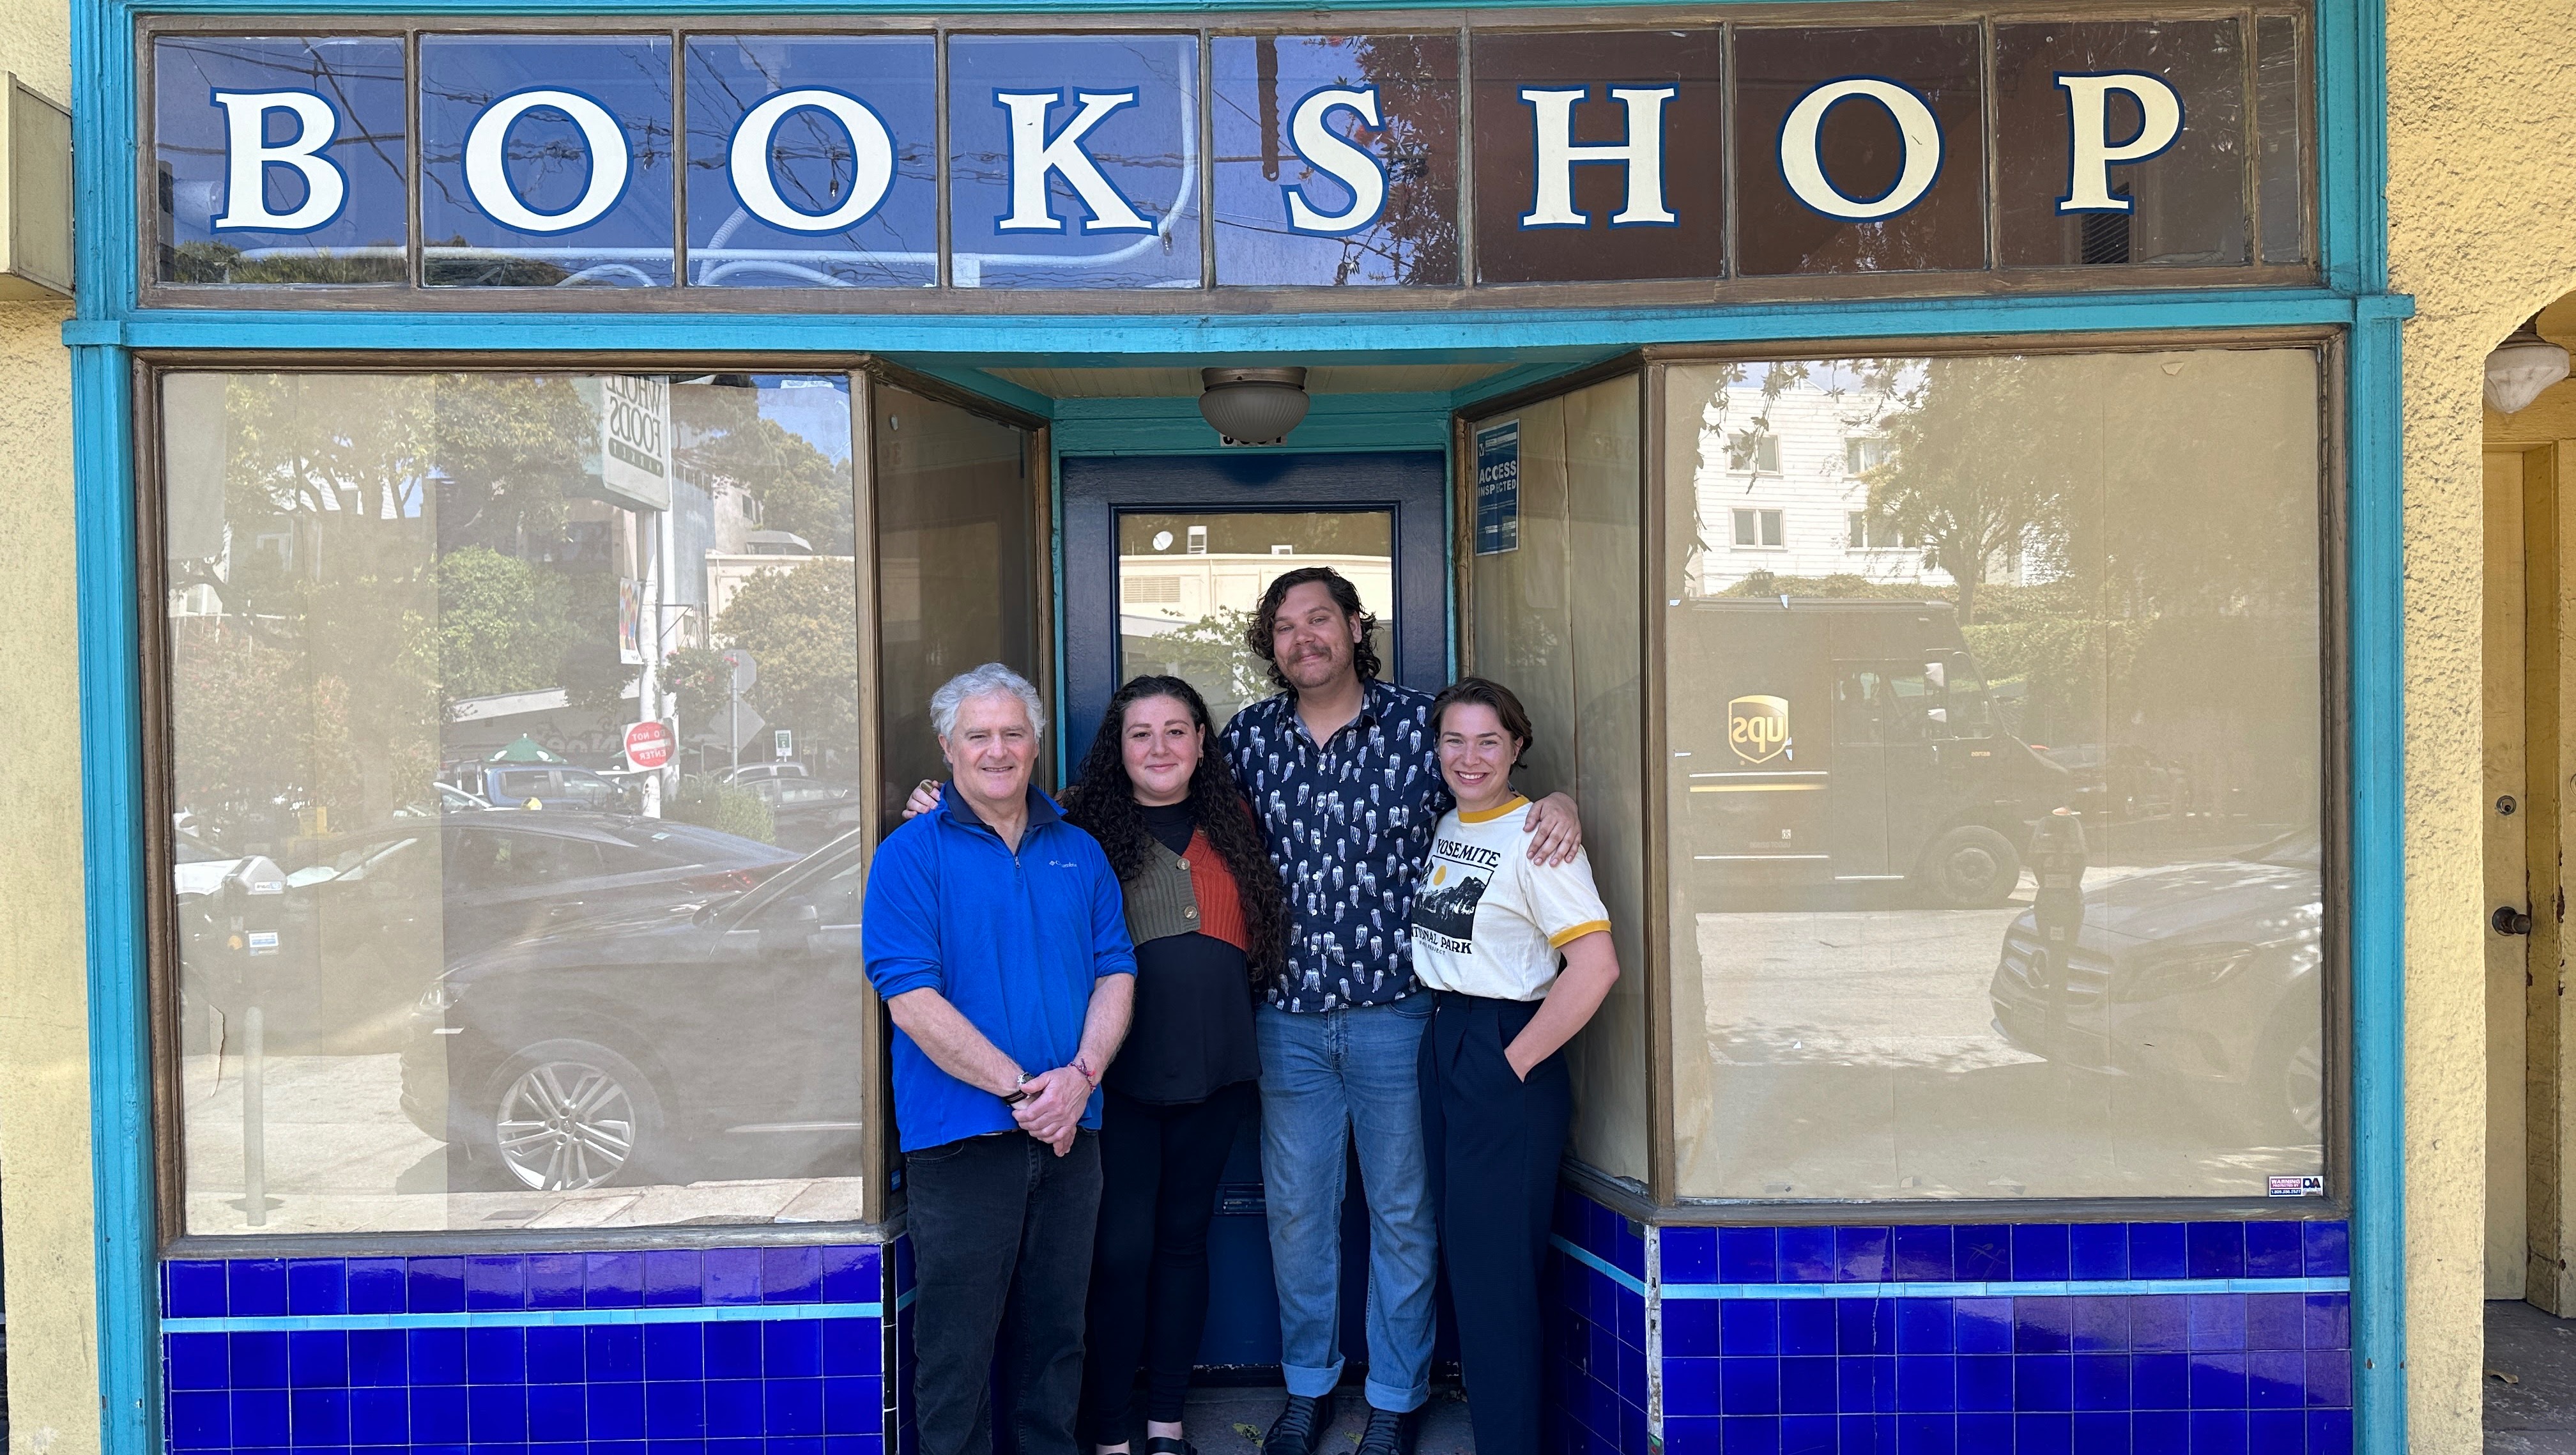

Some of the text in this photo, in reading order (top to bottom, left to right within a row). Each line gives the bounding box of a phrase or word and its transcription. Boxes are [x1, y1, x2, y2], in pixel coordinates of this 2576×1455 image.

[1479, 460, 1517, 484] ACCESS
[1478, 479, 1517, 497] INSPECTED
[1437, 838, 1501, 868] YOSEMITE
[1440, 937, 1472, 954] PARK
